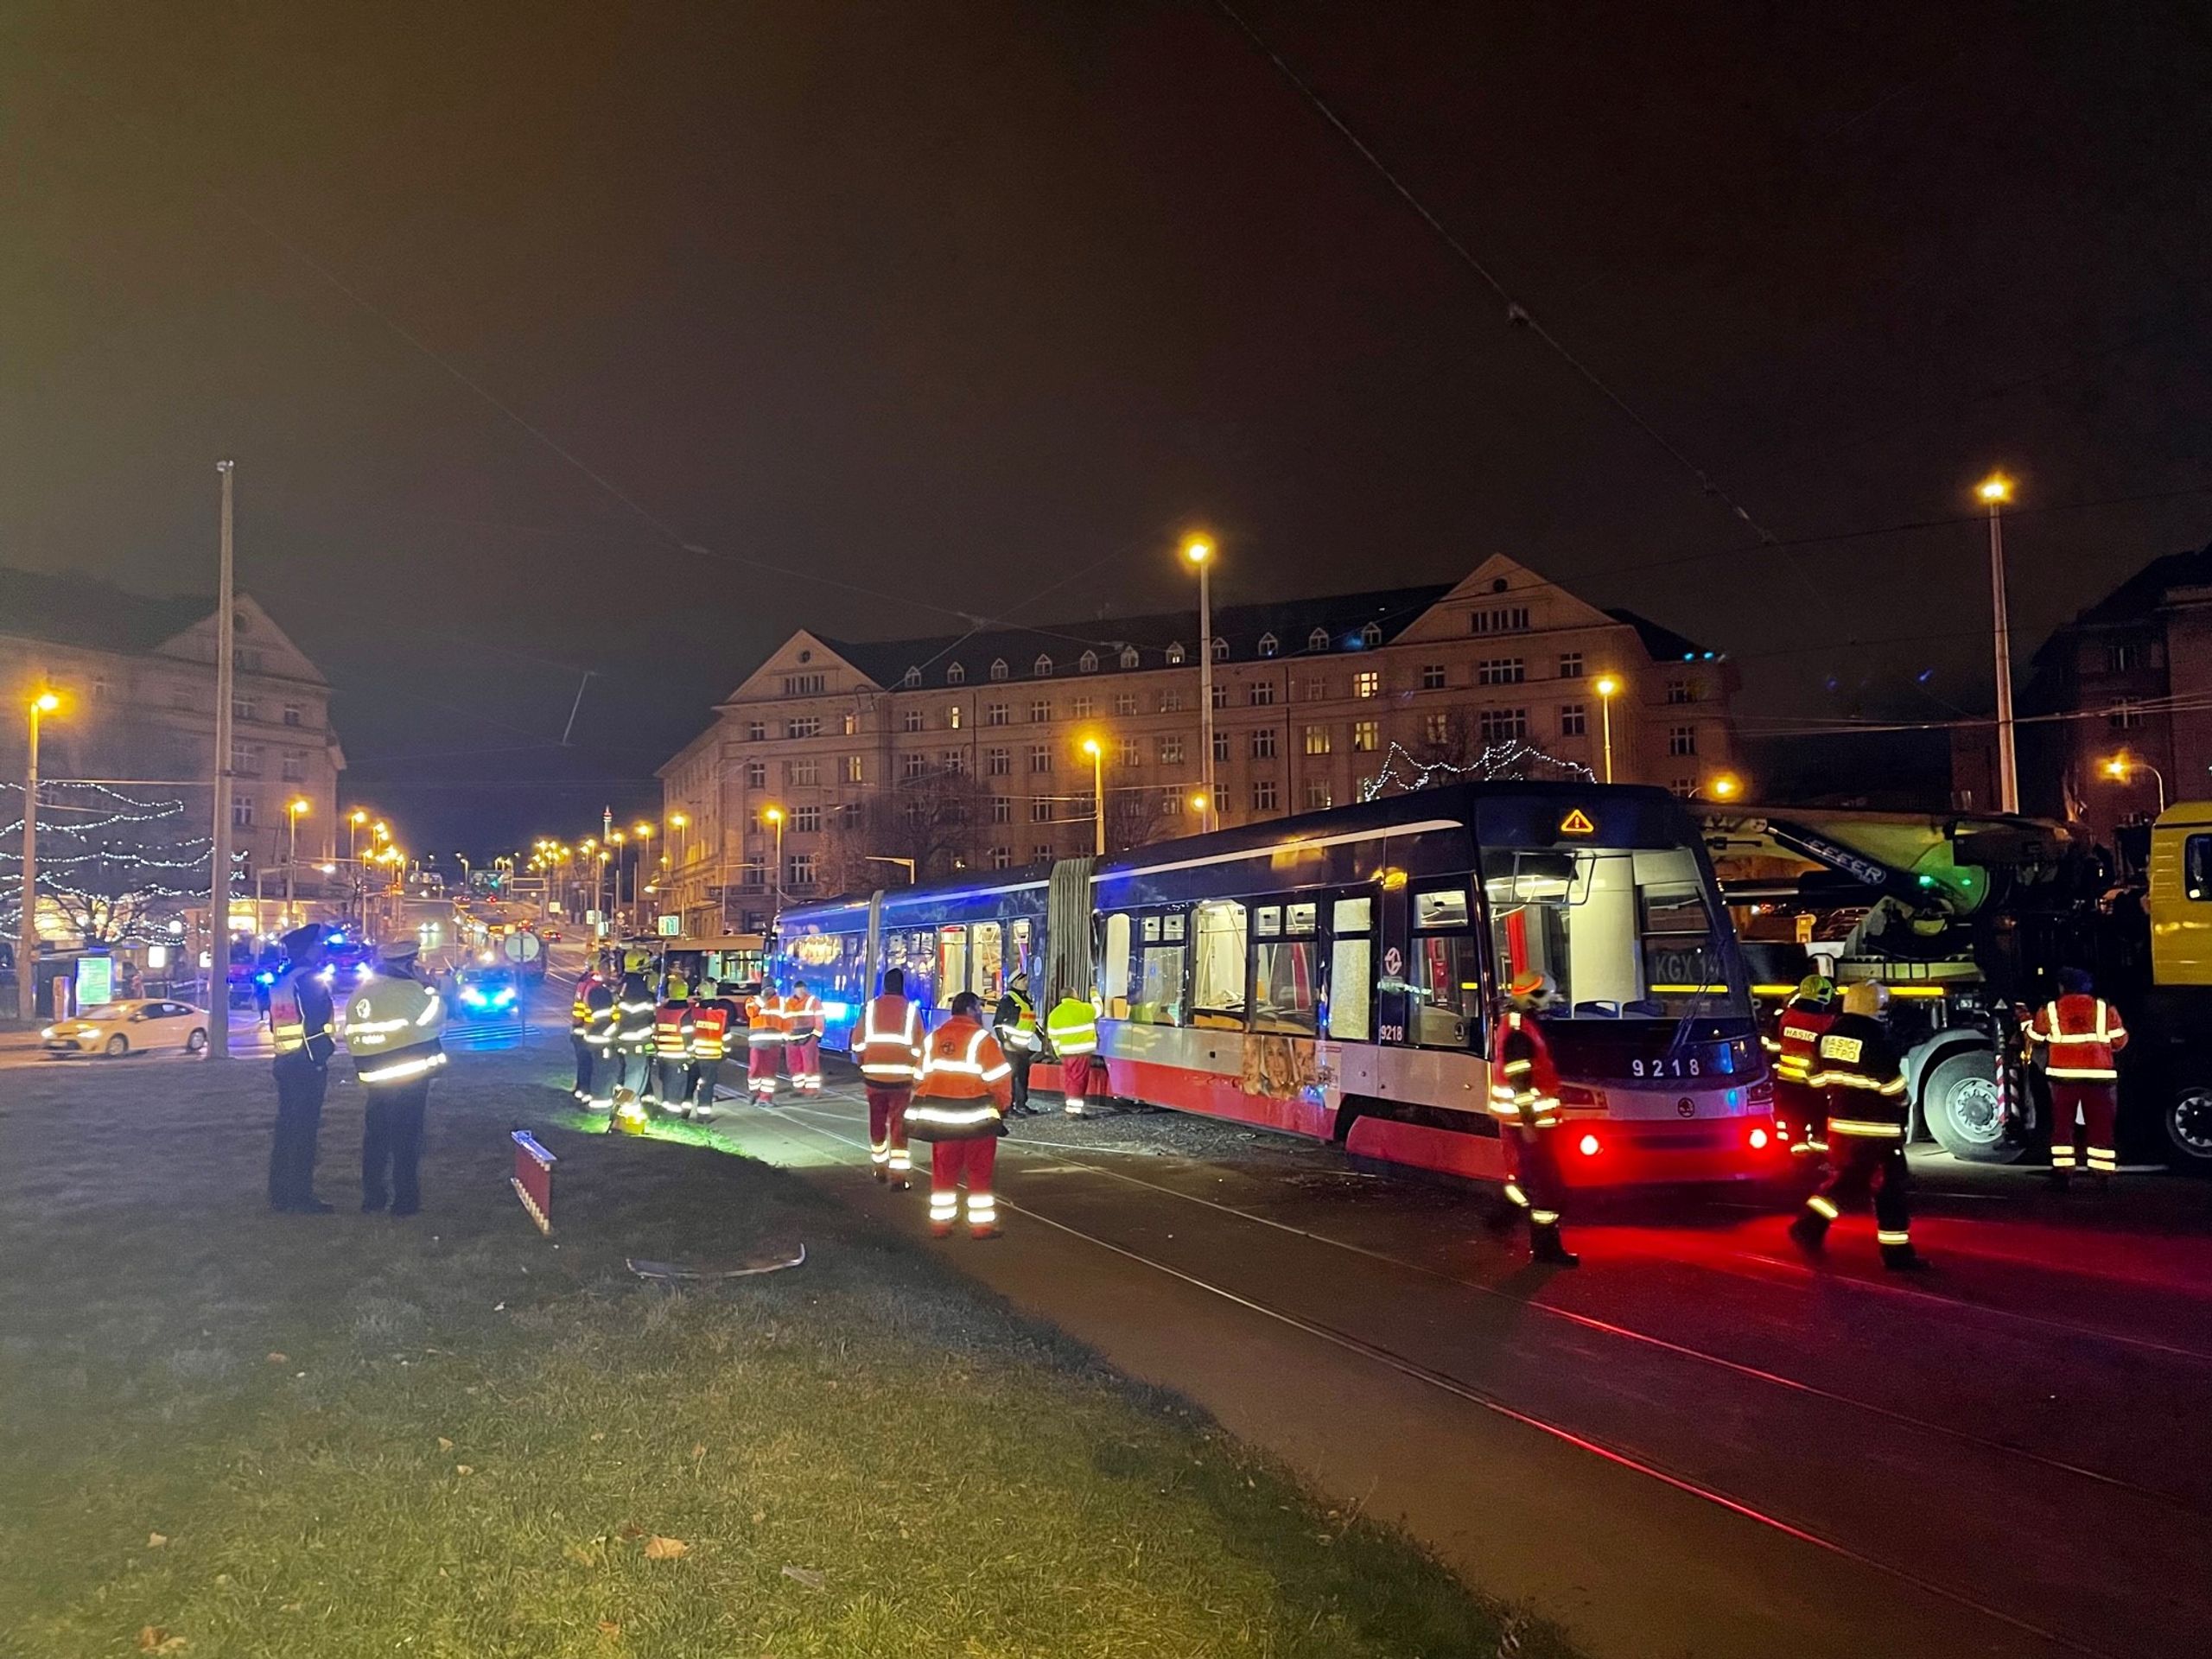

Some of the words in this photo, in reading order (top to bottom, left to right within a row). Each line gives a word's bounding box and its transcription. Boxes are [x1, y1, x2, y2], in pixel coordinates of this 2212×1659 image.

[1656, 954, 1694, 983] KGX
[1381, 1025, 1402, 1042] 9218
[1785, 1028, 1815, 1041] HASIC
[1632, 1058, 1700, 1077] 9218
